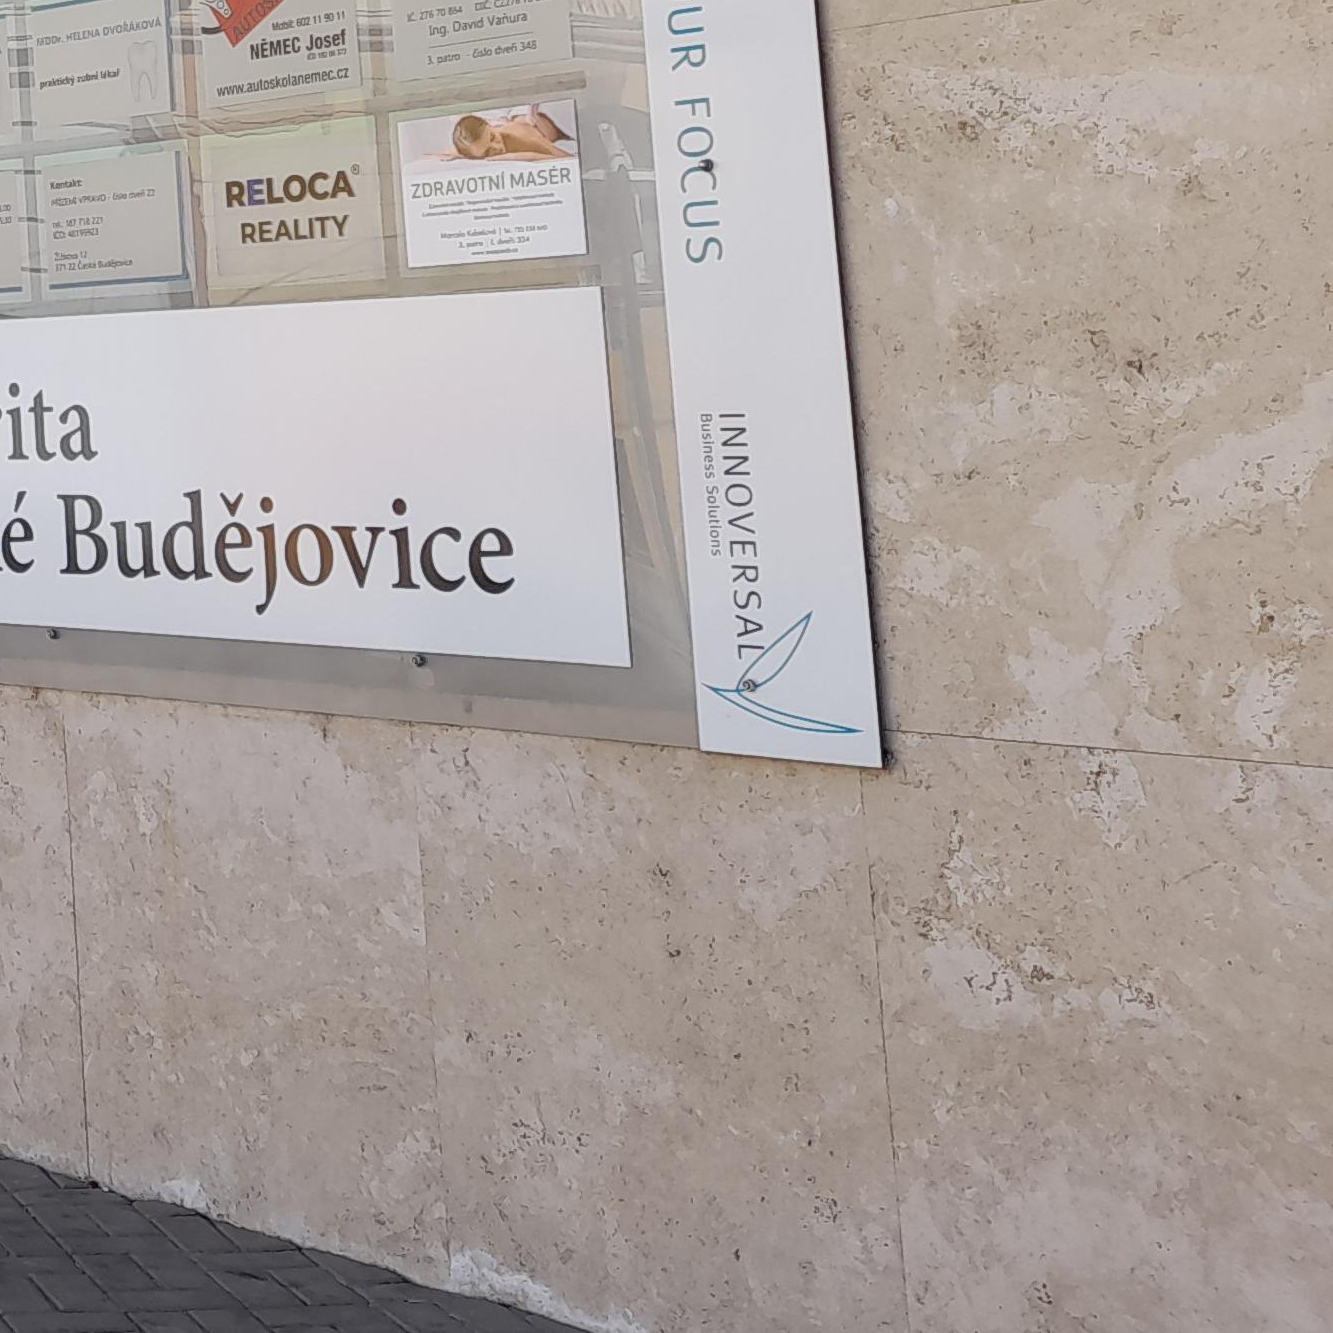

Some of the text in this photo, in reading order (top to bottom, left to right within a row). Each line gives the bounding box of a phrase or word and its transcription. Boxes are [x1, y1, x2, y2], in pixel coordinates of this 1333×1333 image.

[66, 29, 100, 42] HELENA
[103, 17, 162, 37] DVOŘÁKOVÁ
[429, 12, 528, 37] Ing. David Vaňura
[250, 29, 346, 60] NĚMEC Josef
[437, 52, 460, 64] patro
[40, 74, 75, 90] praktický
[77, 72, 98, 84] zubní
[217, 68, 349, 97] www.autoskolanemec.cz
[225, 170, 356, 208] RELOCA
[411, 165, 571, 199] ZDRAVOTNÍ MASÉR
[674, 97, 723, 264] FOCUS
[241, 215, 350, 244] REALITY
[700, 413, 721, 557] Business Solutions
[56, 489, 516, 615] Budějovice
[718, 413, 765, 660] INNOVERSAL
